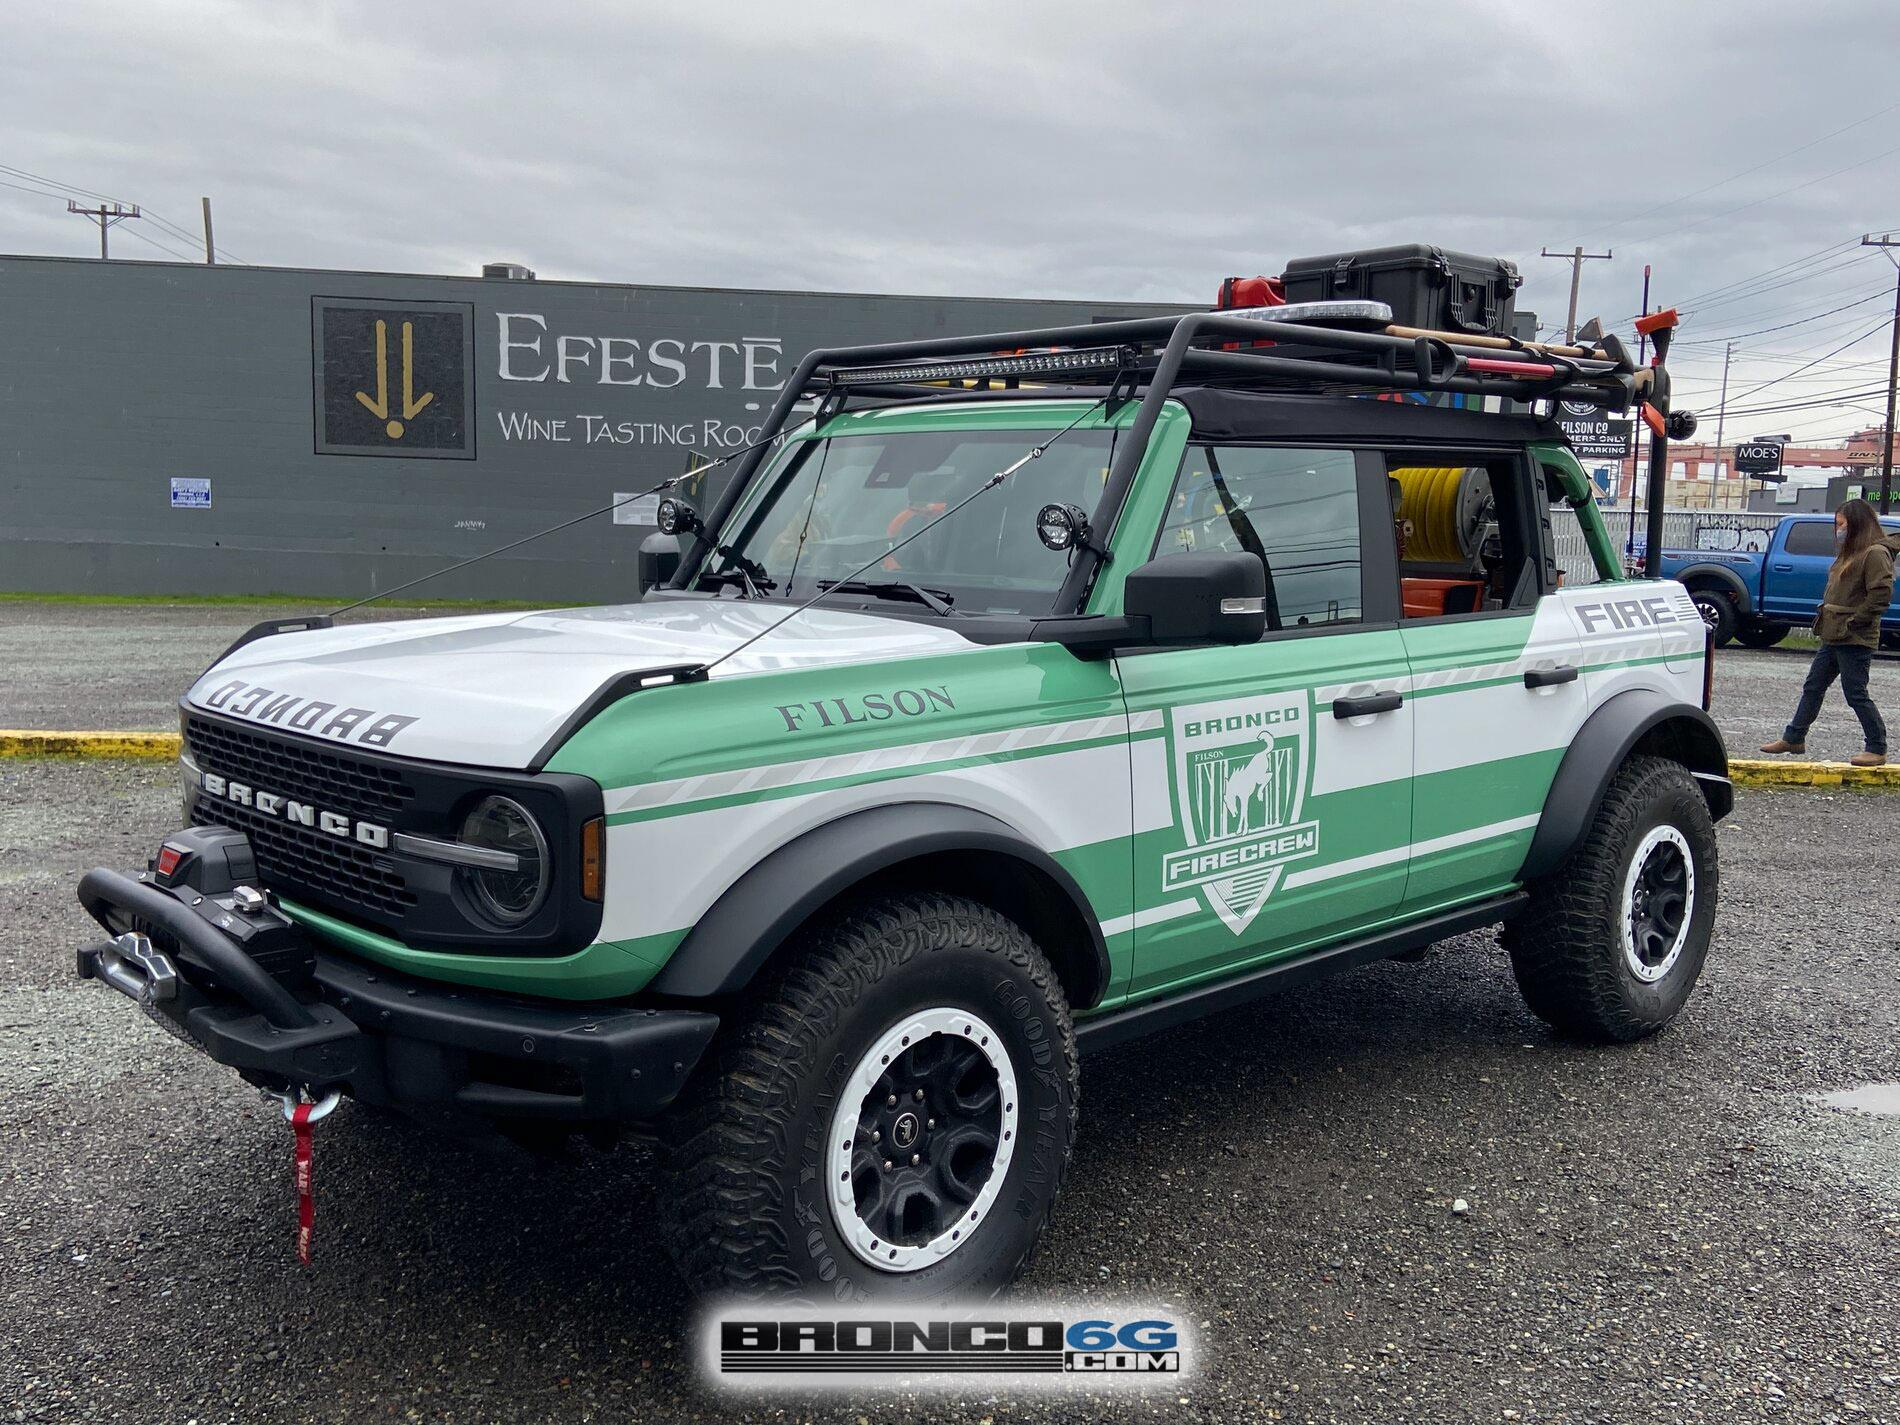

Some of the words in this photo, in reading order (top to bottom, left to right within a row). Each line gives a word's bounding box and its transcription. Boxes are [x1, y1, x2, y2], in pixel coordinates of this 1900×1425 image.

[497, 411, 571, 442] WINE
[576, 415, 695, 446] TASTING
[1561, 421, 1593, 434] FILSON
[1583, 446, 1626, 454] PARKING
[1738, 447, 1778, 459] MOE'S
[1574, 597, 1676, 633] FIRE
[774, 685, 957, 732] FILSON
[1184, 706, 1300, 738] BRONCO
[1194, 750, 1224, 762] FILSON
[203, 772, 389, 849] BRONCO
[1170, 830, 1315, 880] FIRECREW
